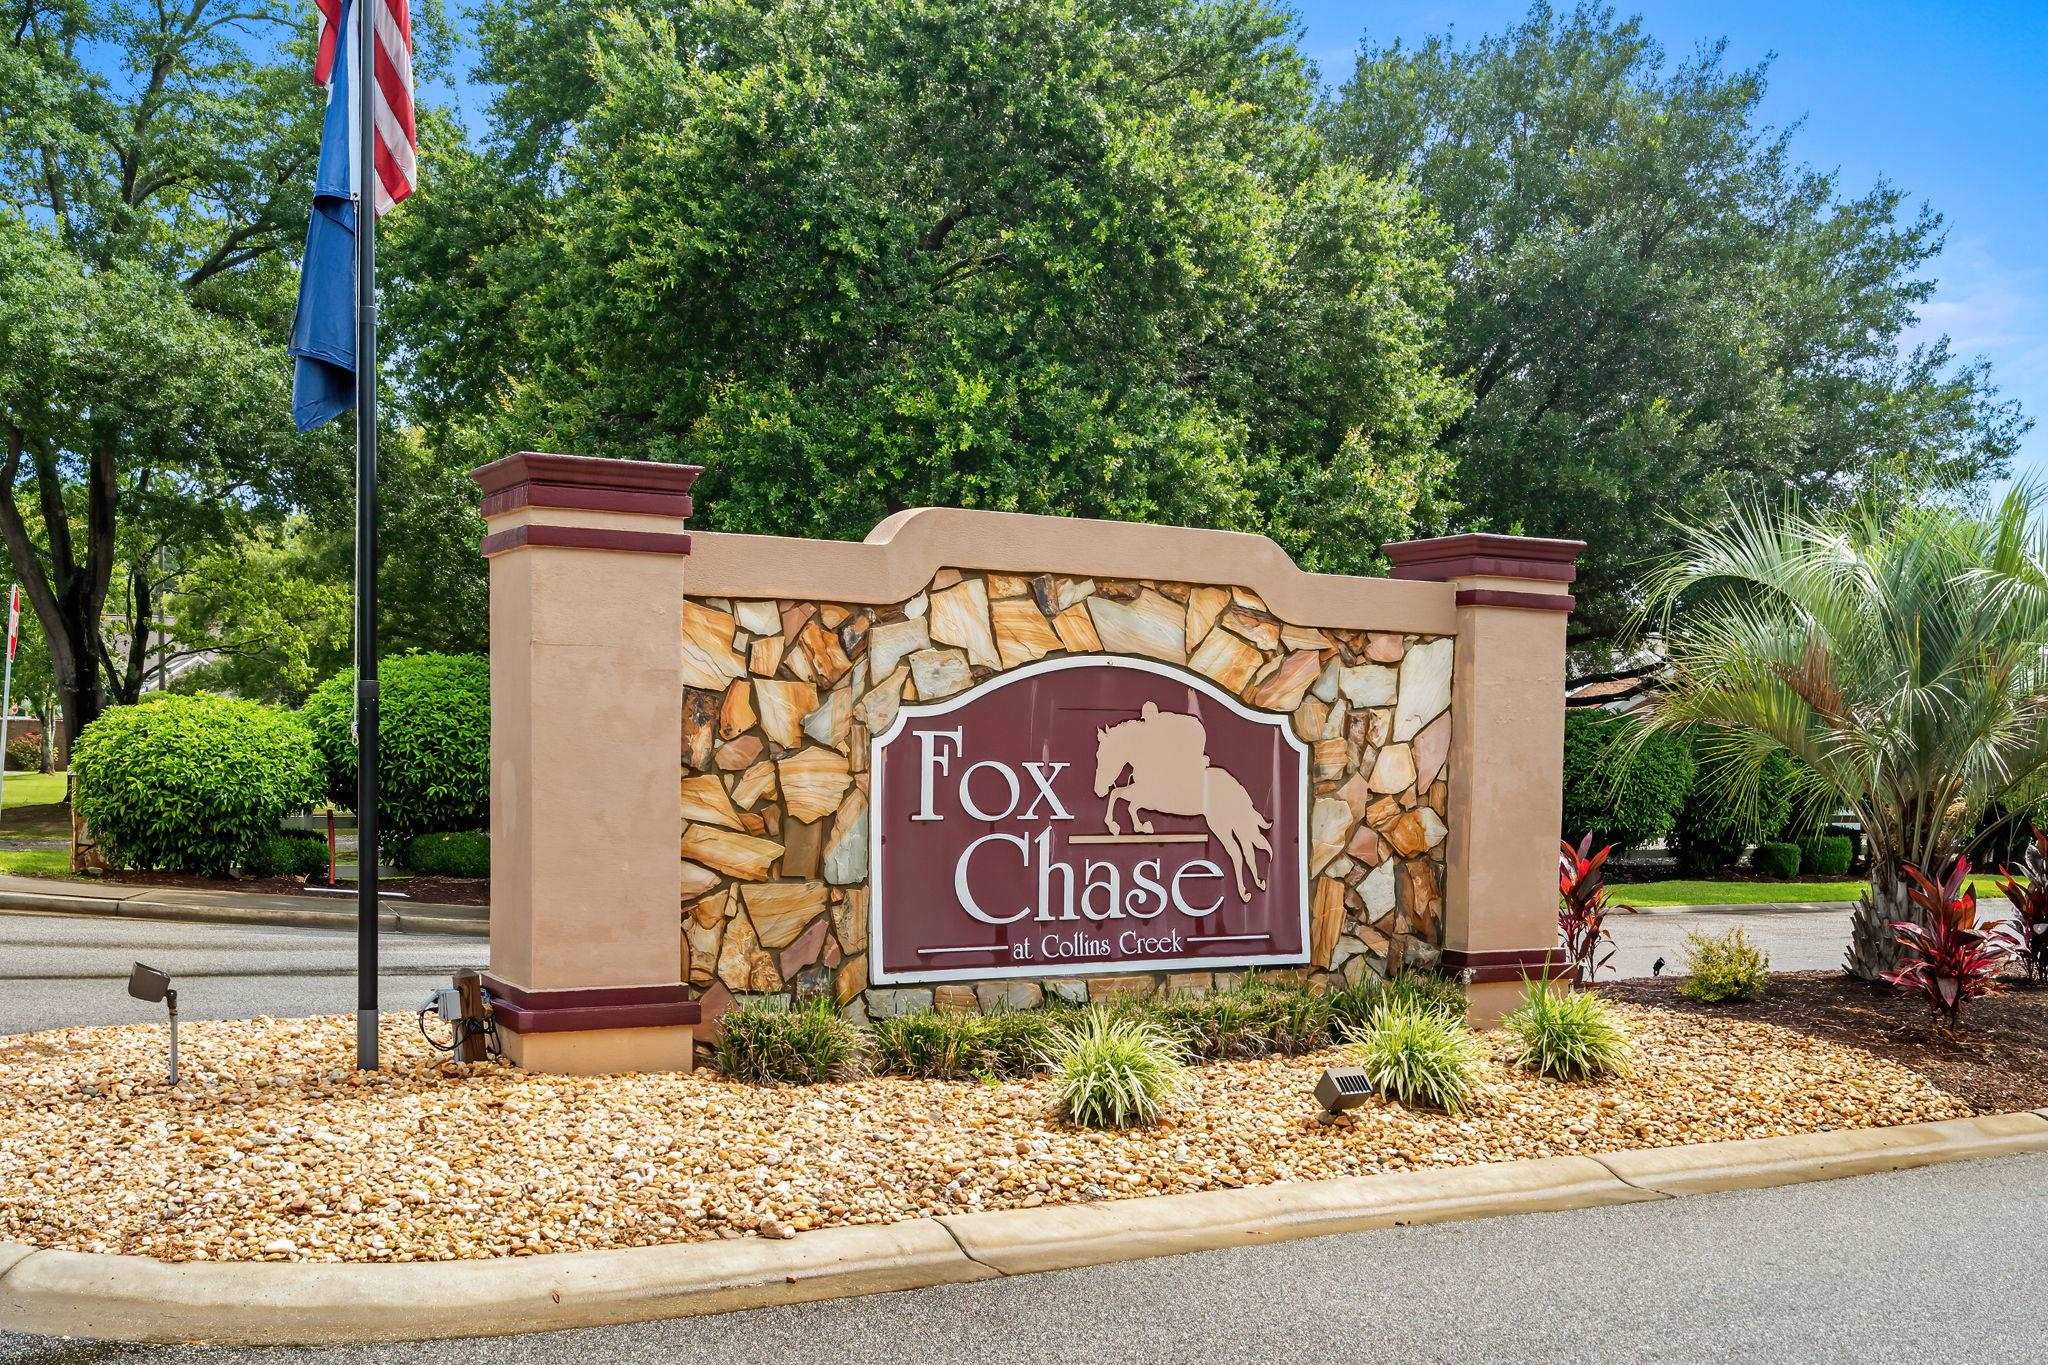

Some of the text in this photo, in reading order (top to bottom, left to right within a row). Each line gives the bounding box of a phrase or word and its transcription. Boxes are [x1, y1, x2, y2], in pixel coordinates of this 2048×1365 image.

[911, 725, 1075, 823] Fox
[954, 825, 1225, 925] Chase
[1012, 926, 1184, 960] at Collins Creek
